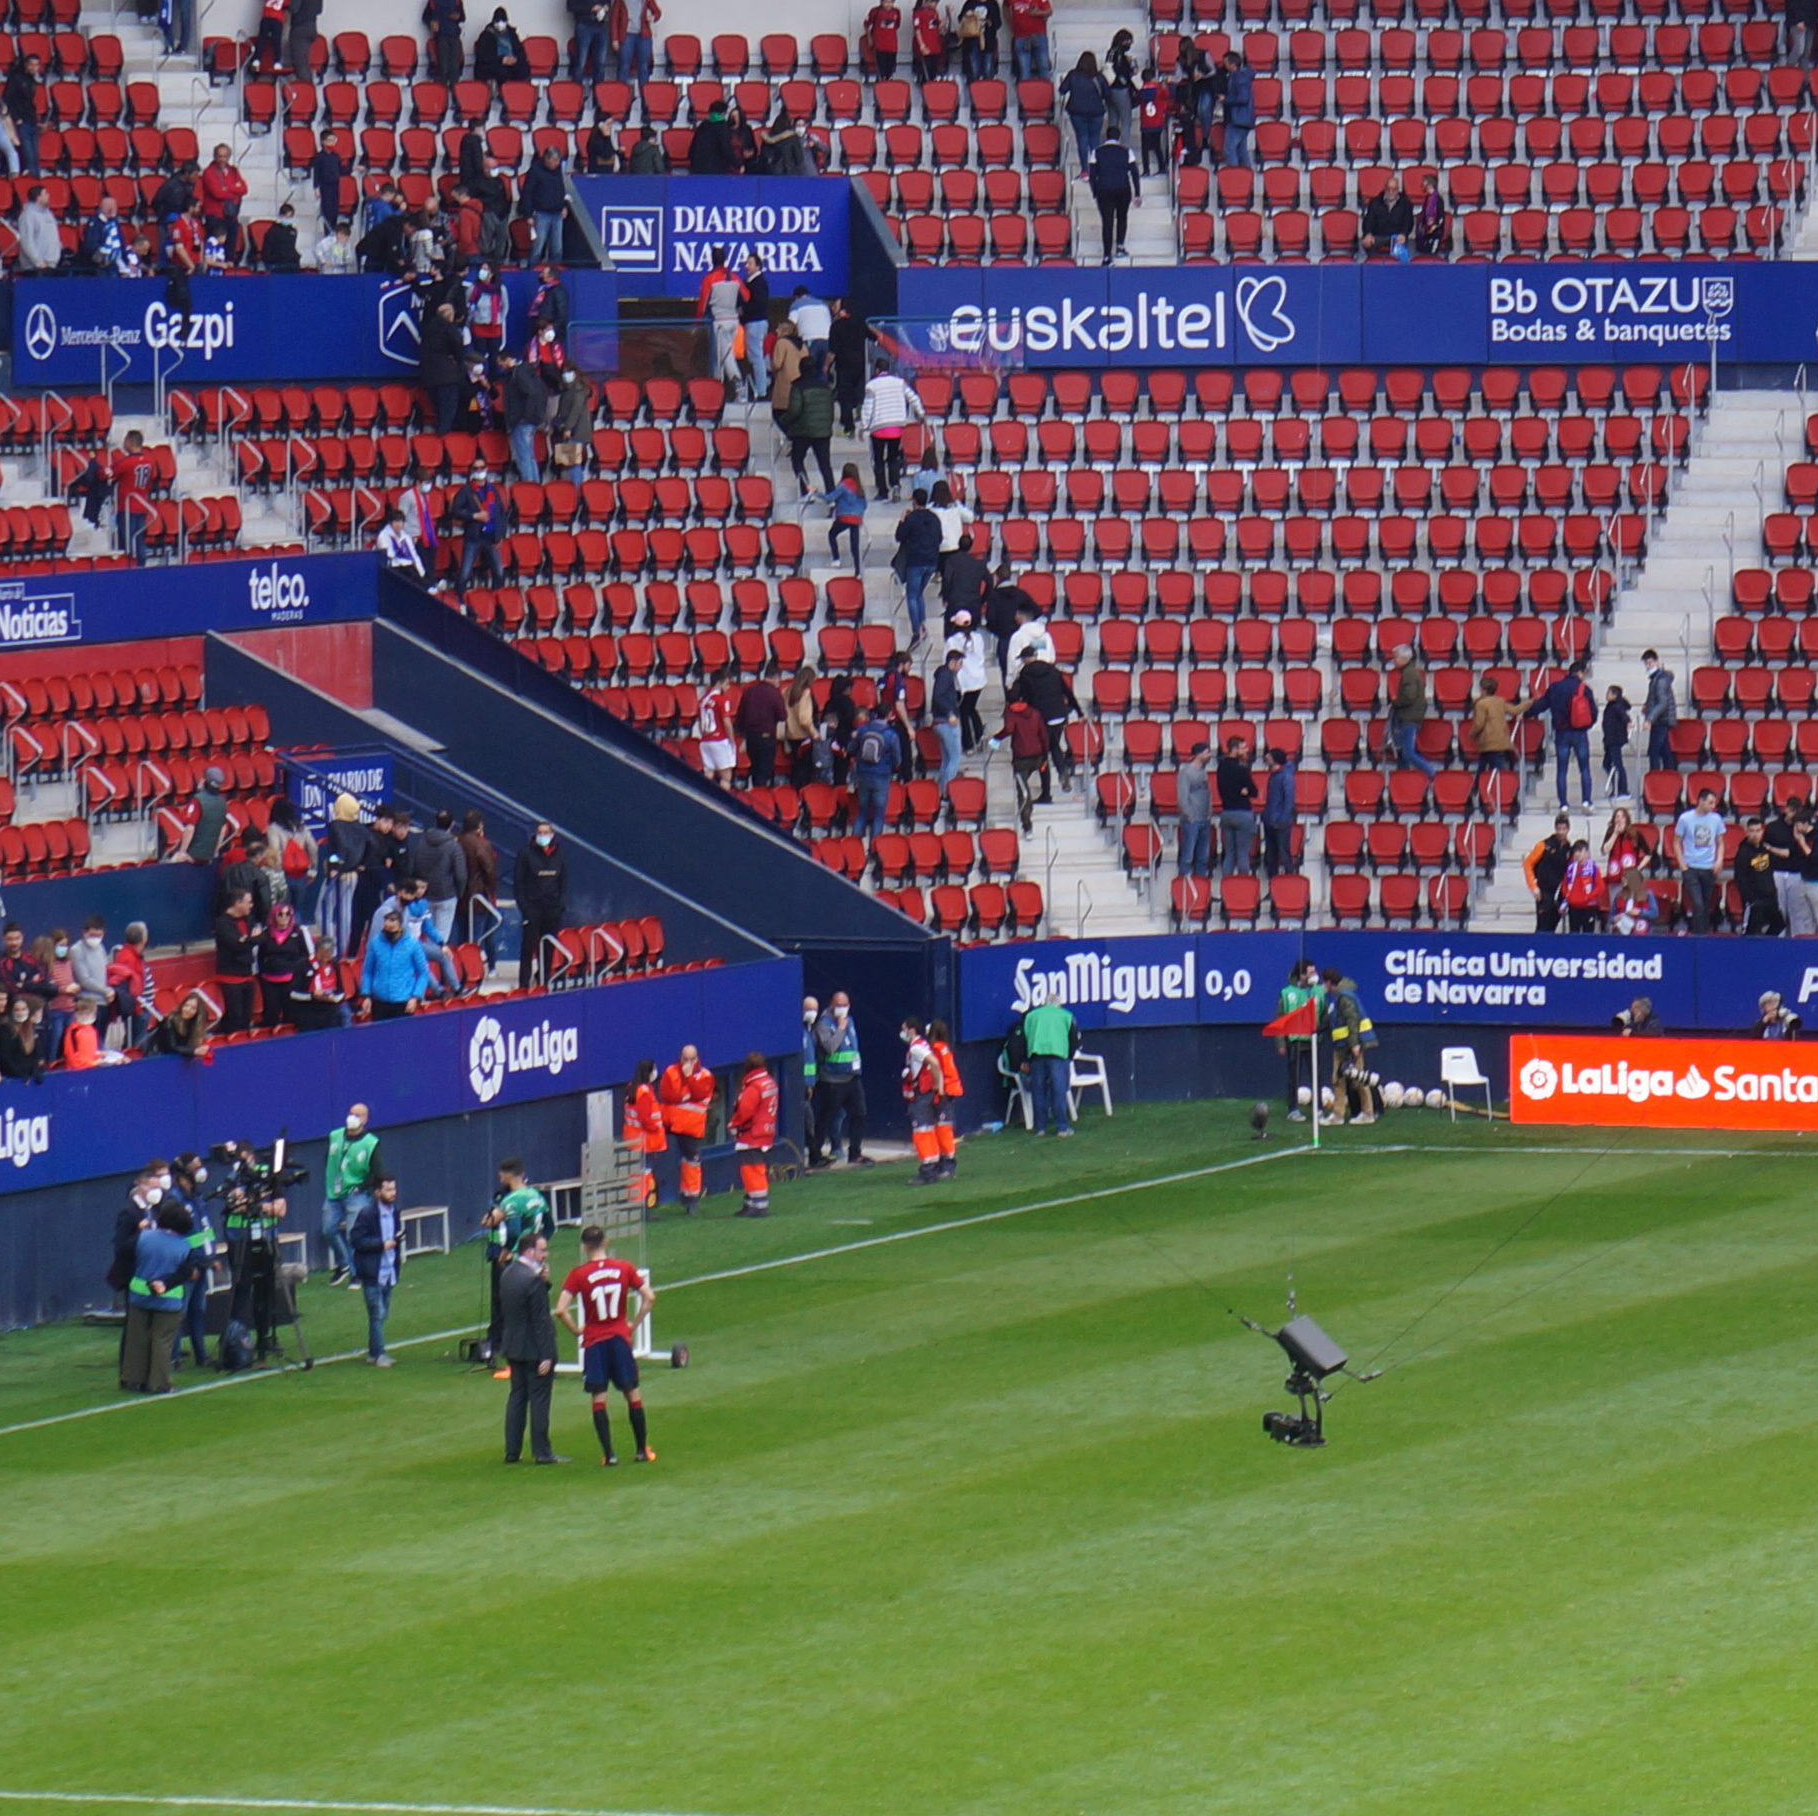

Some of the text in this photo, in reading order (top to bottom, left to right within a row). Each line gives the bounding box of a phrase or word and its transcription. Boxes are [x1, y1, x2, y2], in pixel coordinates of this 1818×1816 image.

[1145, 100, 1157, 118] 6
[609, 216, 655, 247] DN
[672, 205, 821, 234] DIARIO DE
[672, 241, 824, 273] NAVARRA
[1490, 277, 1700, 314] Bb OTAZU
[60, 300, 235, 360] Mercedes-Benz Gazpi
[949, 290, 1225, 352] euskaltel
[1491, 318, 1731, 347] Bodas & banquetes
[367, 767, 385, 792] DE
[1384, 947, 1663, 980] Clínica Universidad
[1010, 950, 1195, 1014] SanMiguel
[1384, 977, 1546, 1006] de Navarra
[507, 1018, 578, 1076] LaLiga
[1561, 1059, 1674, 1104] LaLiga
[589, 1283, 623, 1322] 17
